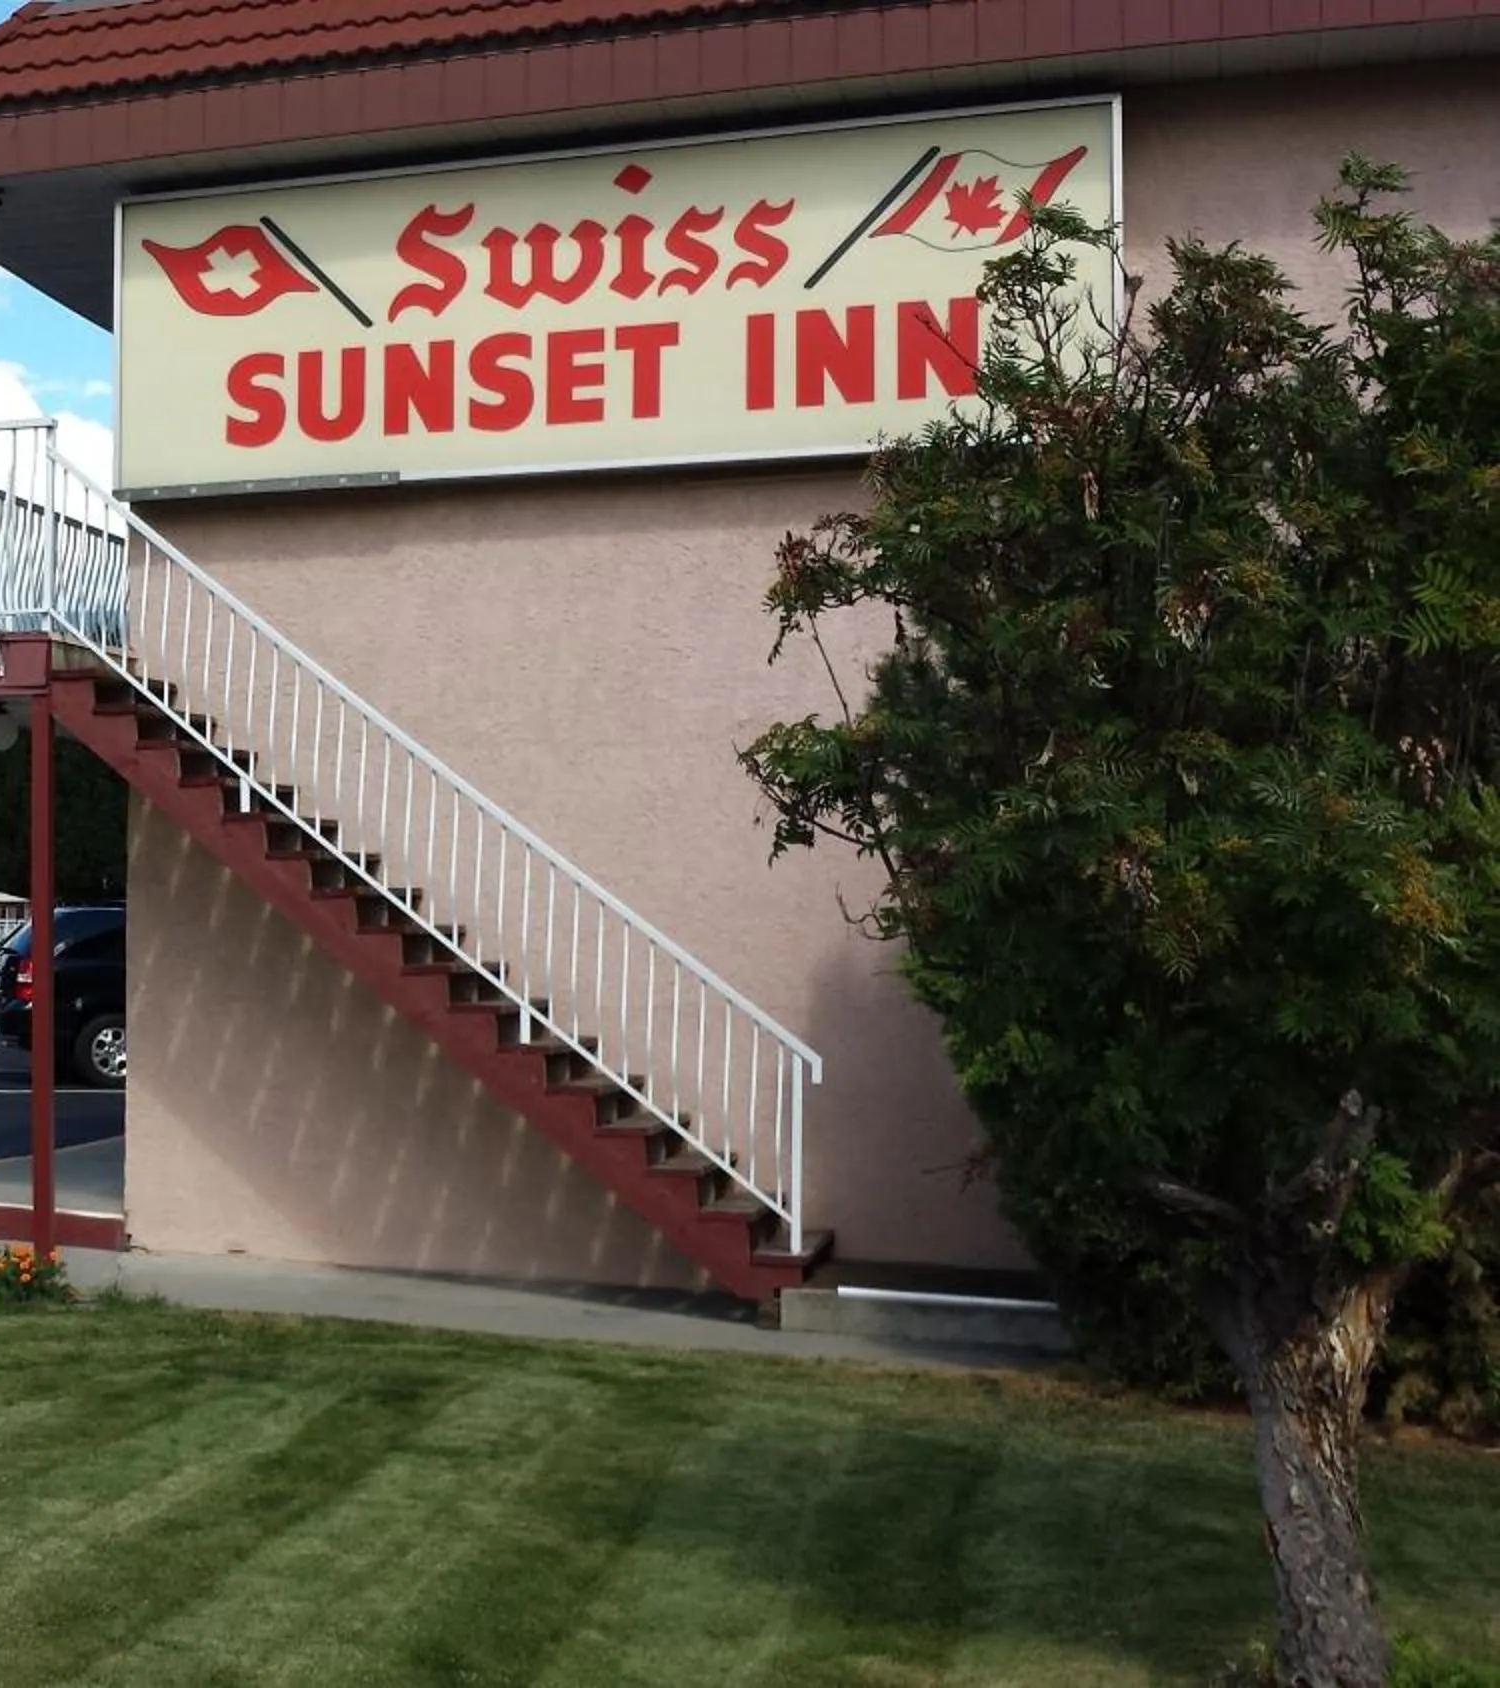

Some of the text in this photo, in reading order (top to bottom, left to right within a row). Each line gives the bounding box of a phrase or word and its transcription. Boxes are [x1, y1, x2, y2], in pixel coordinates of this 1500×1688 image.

[387, 163, 794, 322] Swiss
[225, 296, 981, 449] SUNSET INN
